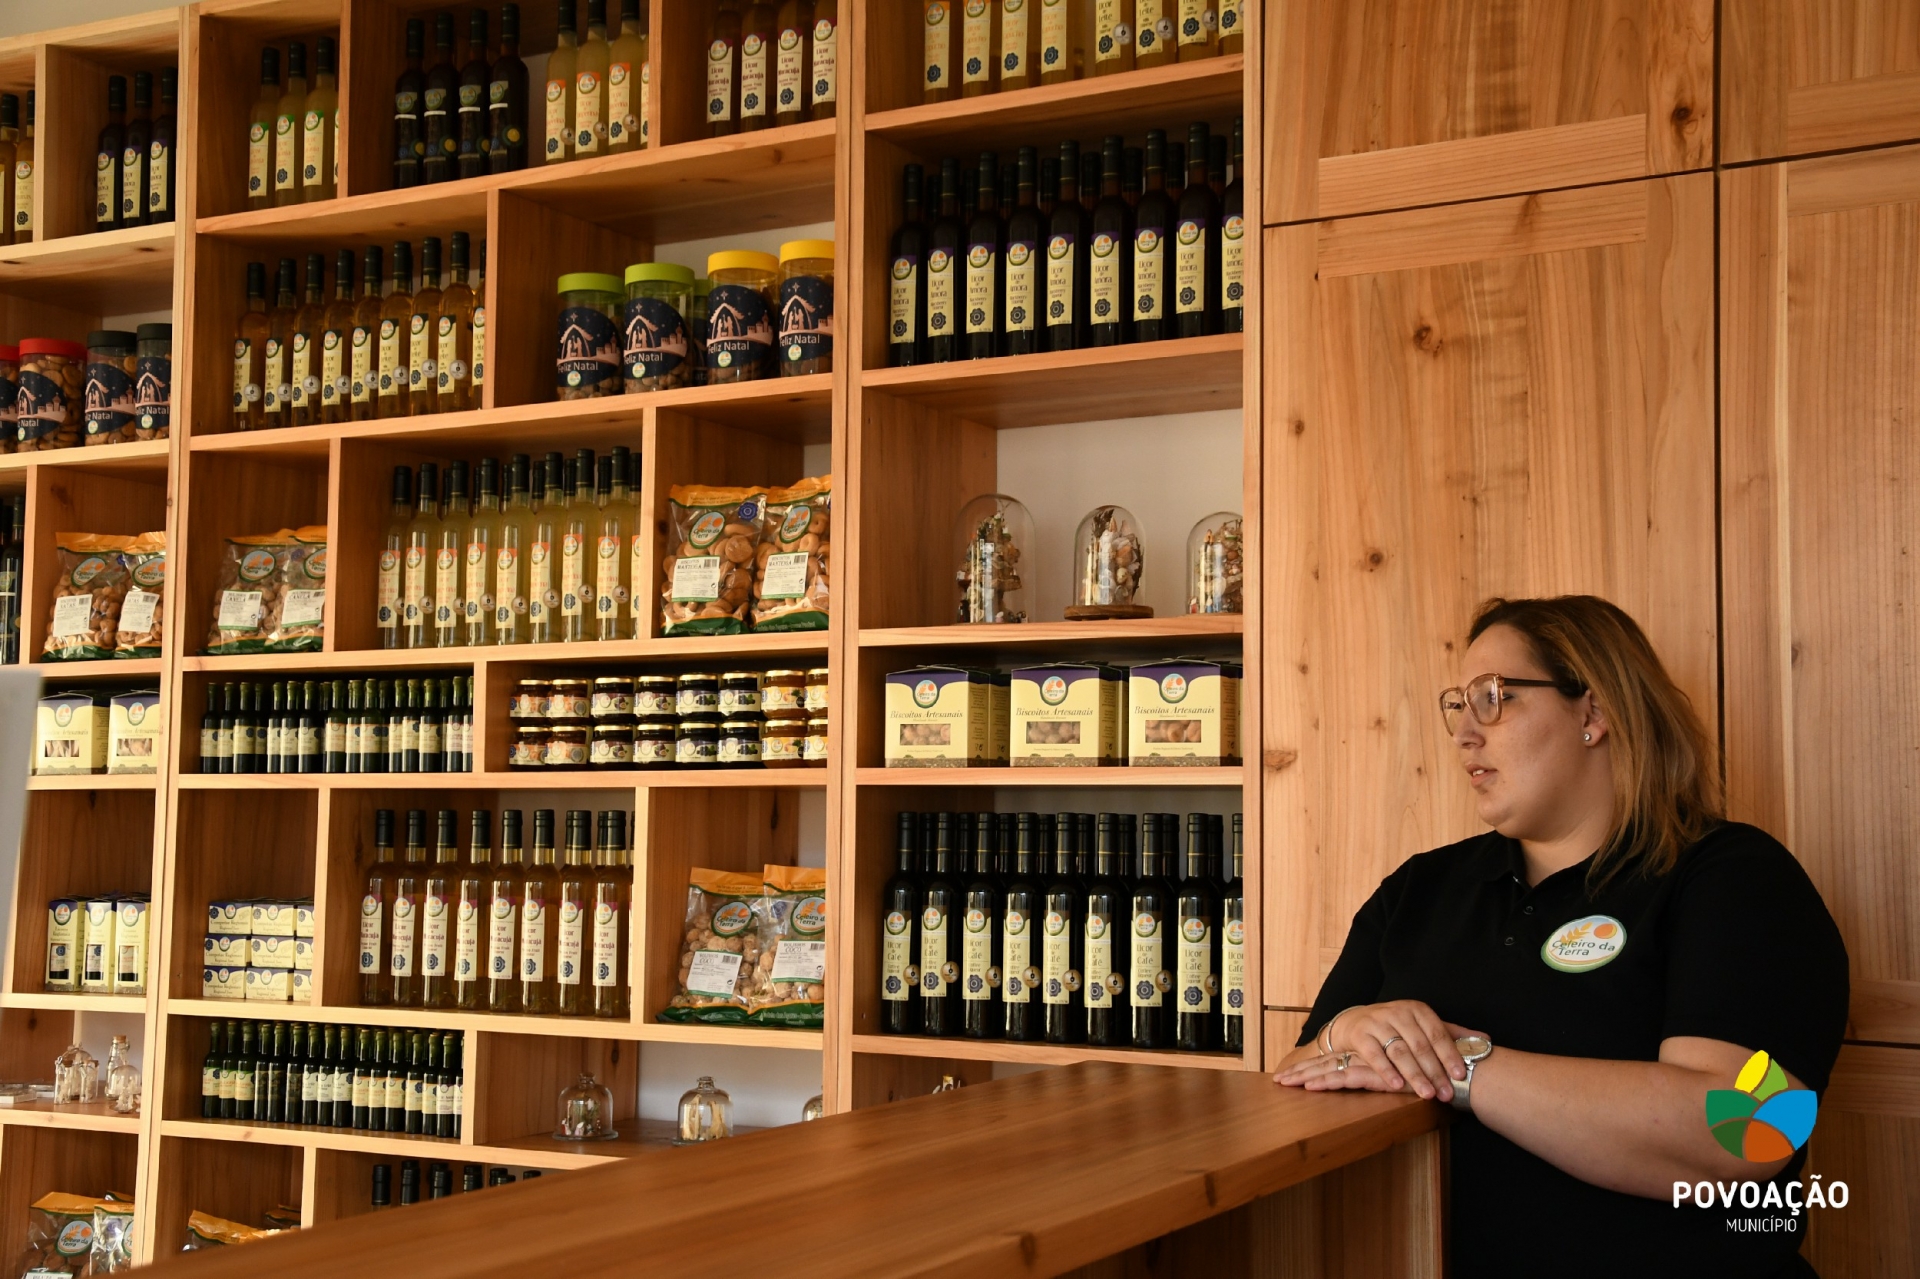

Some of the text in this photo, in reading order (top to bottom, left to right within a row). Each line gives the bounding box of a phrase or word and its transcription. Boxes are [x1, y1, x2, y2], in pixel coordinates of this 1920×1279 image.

[794, 333, 821, 345] Natal
[724, 341, 750, 352] Natal
[638, 351, 663, 363] Natal
[573, 361, 599, 372] Natal
[147, 405, 169, 415] Natal
[92, 411, 114, 420] Natal
[21, 418, 39, 427] Natal
[890, 710, 963, 719] Biscoitos Artesanais
[1016, 708, 1093, 716] Biscoitos Artesanais
[1134, 706, 1215, 714] Biscoitos Artesanais
[1136, 943, 1153, 952] Licor
[1552, 940, 1616, 952] Celeiro da
[1185, 949, 1203, 959] Licor
[1558, 948, 1590, 956] Terra
[1137, 956, 1154, 965] Café
[1185, 962, 1202, 971] Café
